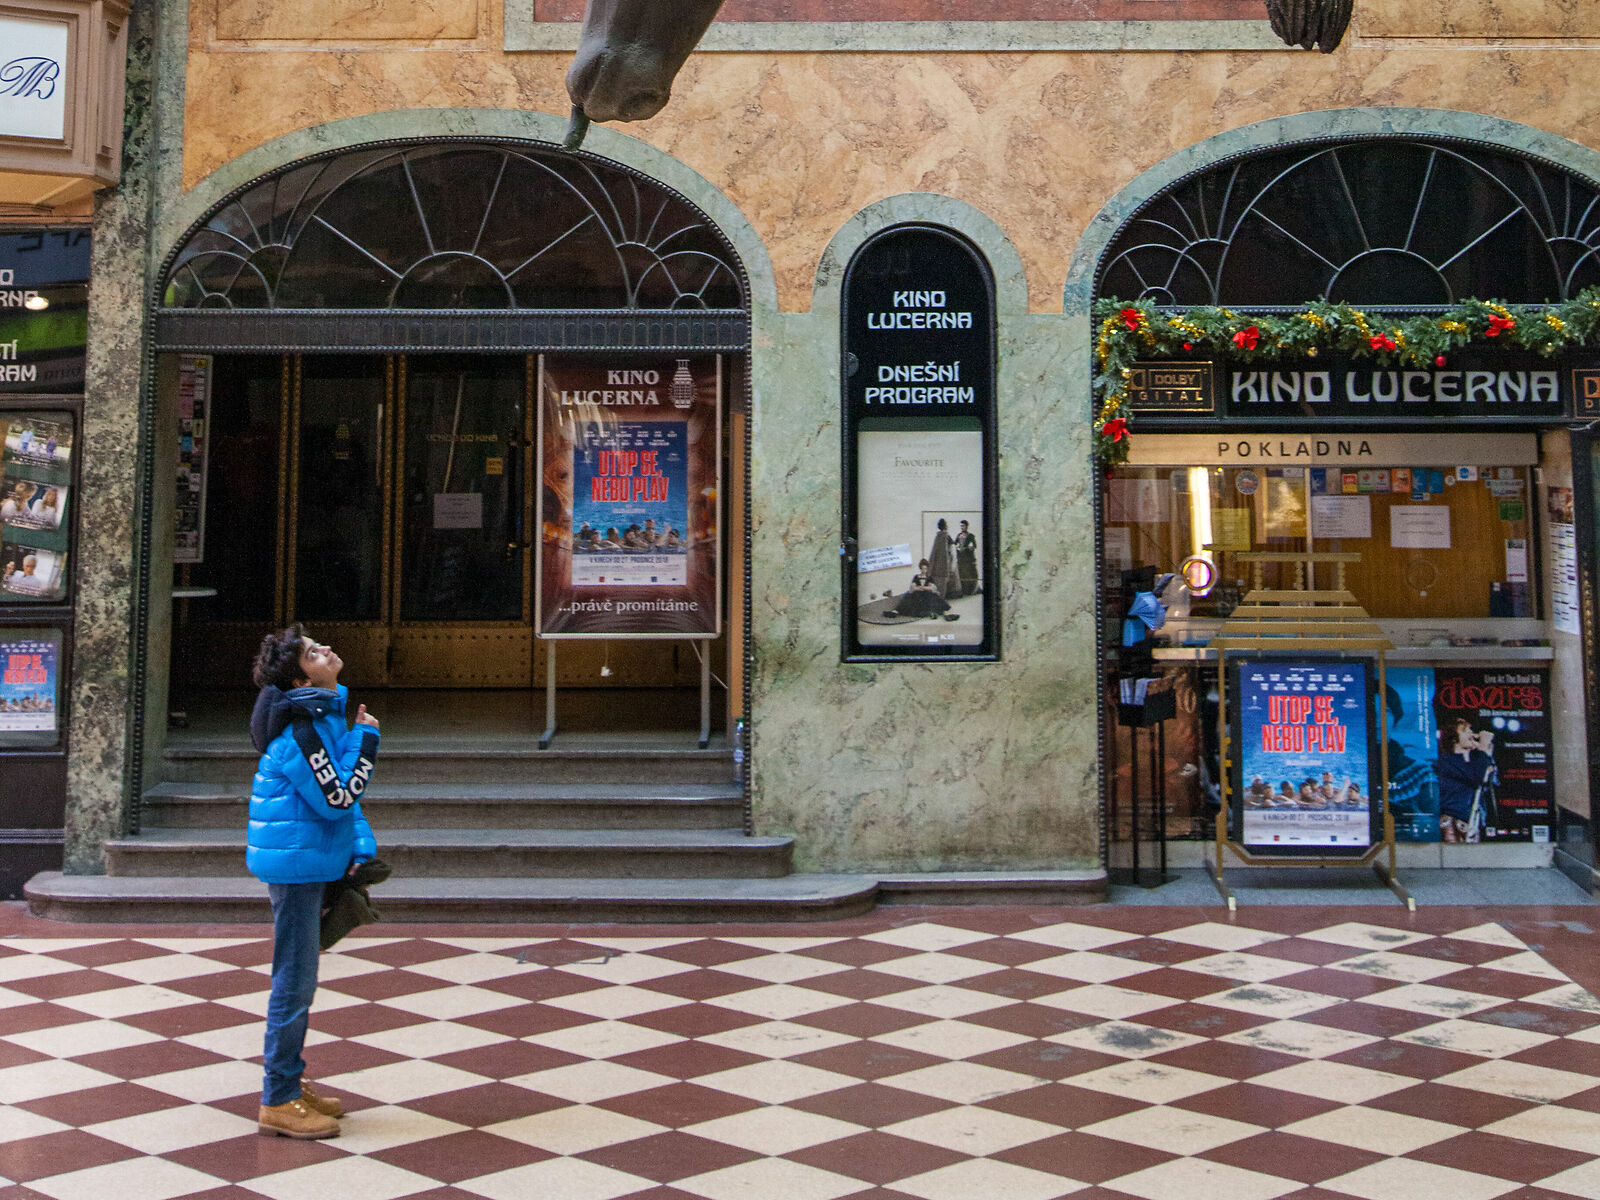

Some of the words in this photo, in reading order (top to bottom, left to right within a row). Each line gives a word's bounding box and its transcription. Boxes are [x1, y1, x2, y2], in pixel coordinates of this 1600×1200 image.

[893, 290, 946, 308] KINO
[867, 312, 973, 329] LUCERNA
[607, 370, 660, 385] KINO
[878, 361, 960, 382] DNEŠNÍ
[1155, 374, 1195, 385] DOLBY
[865, 387, 975, 404] PROGRAM
[1232, 371, 1331, 402] KINO
[1345, 371, 1559, 402] LUCERNA
[561, 390, 660, 406] LUCERNA
[1128, 391, 1203, 401] IGITAL
[1218, 440, 1373, 458] POKLADNA
[598, 450, 638, 476] UTOP
[640, 450, 662, 478] SE,
[592, 476, 630, 502] NEBO
[632, 476, 669, 502] PLAV
[616, 598, 699, 615] promítáme
[1268, 696, 1311, 724] UTOP
[1313, 696, 1339, 726] SE,
[1261, 725, 1304, 753] NEBO
[1306, 725, 1347, 753] PLAV
